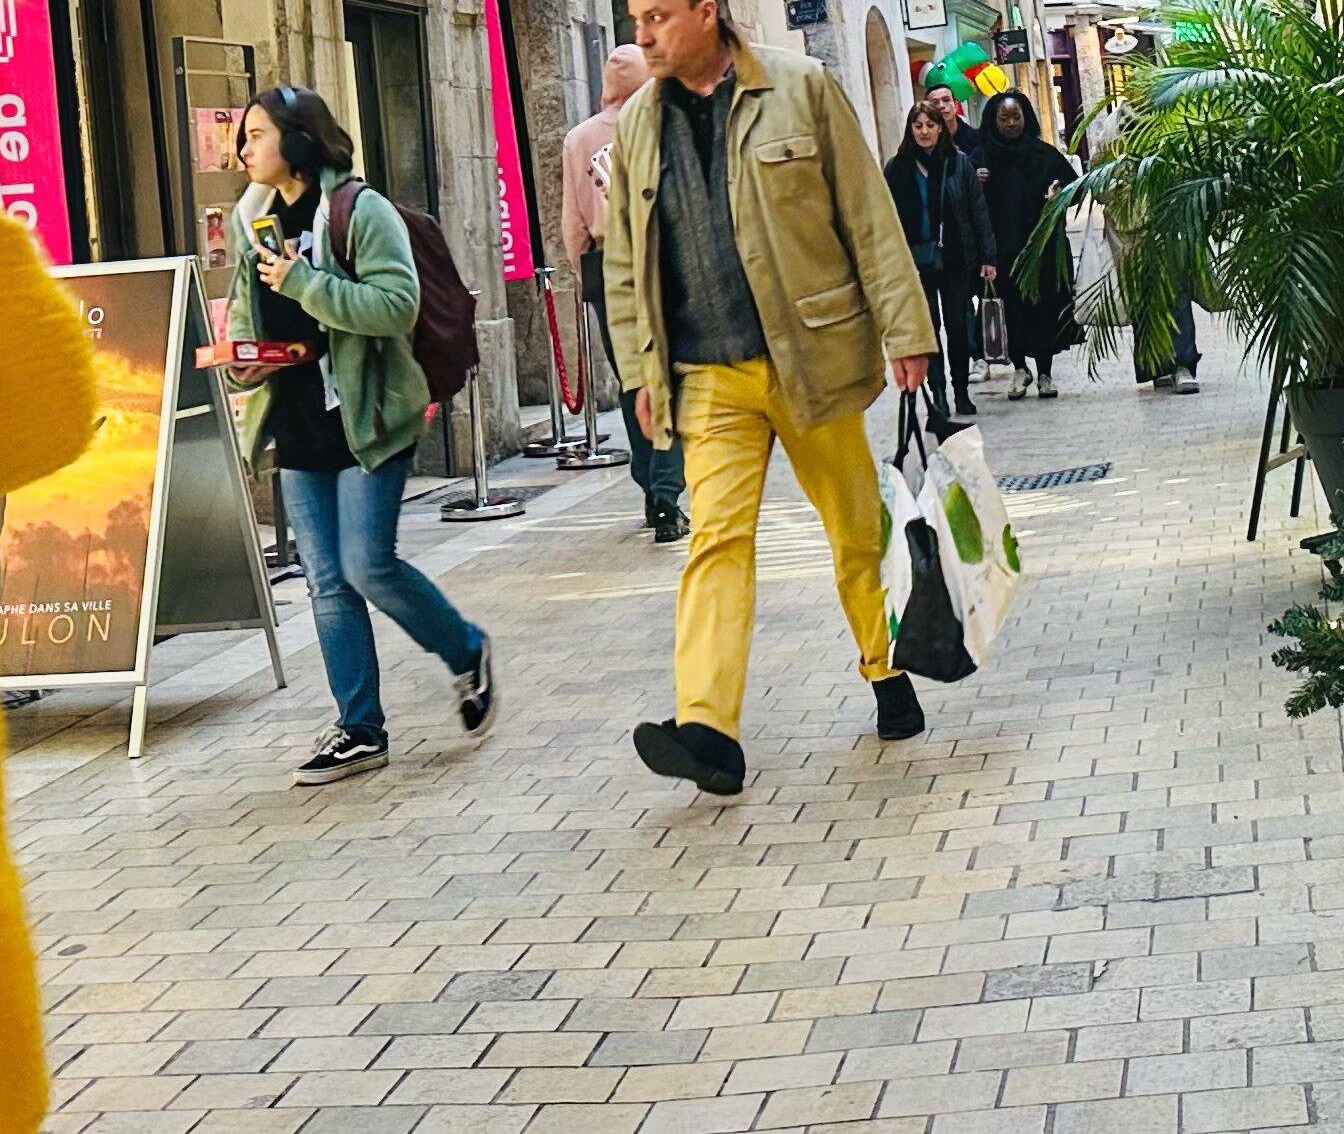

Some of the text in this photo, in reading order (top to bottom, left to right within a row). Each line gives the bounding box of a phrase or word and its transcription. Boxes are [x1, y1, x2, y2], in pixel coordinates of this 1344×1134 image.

[28, 601, 61, 614] DANS
[63, 601, 79, 613] SA
[82, 599, 113, 612] VILLE
